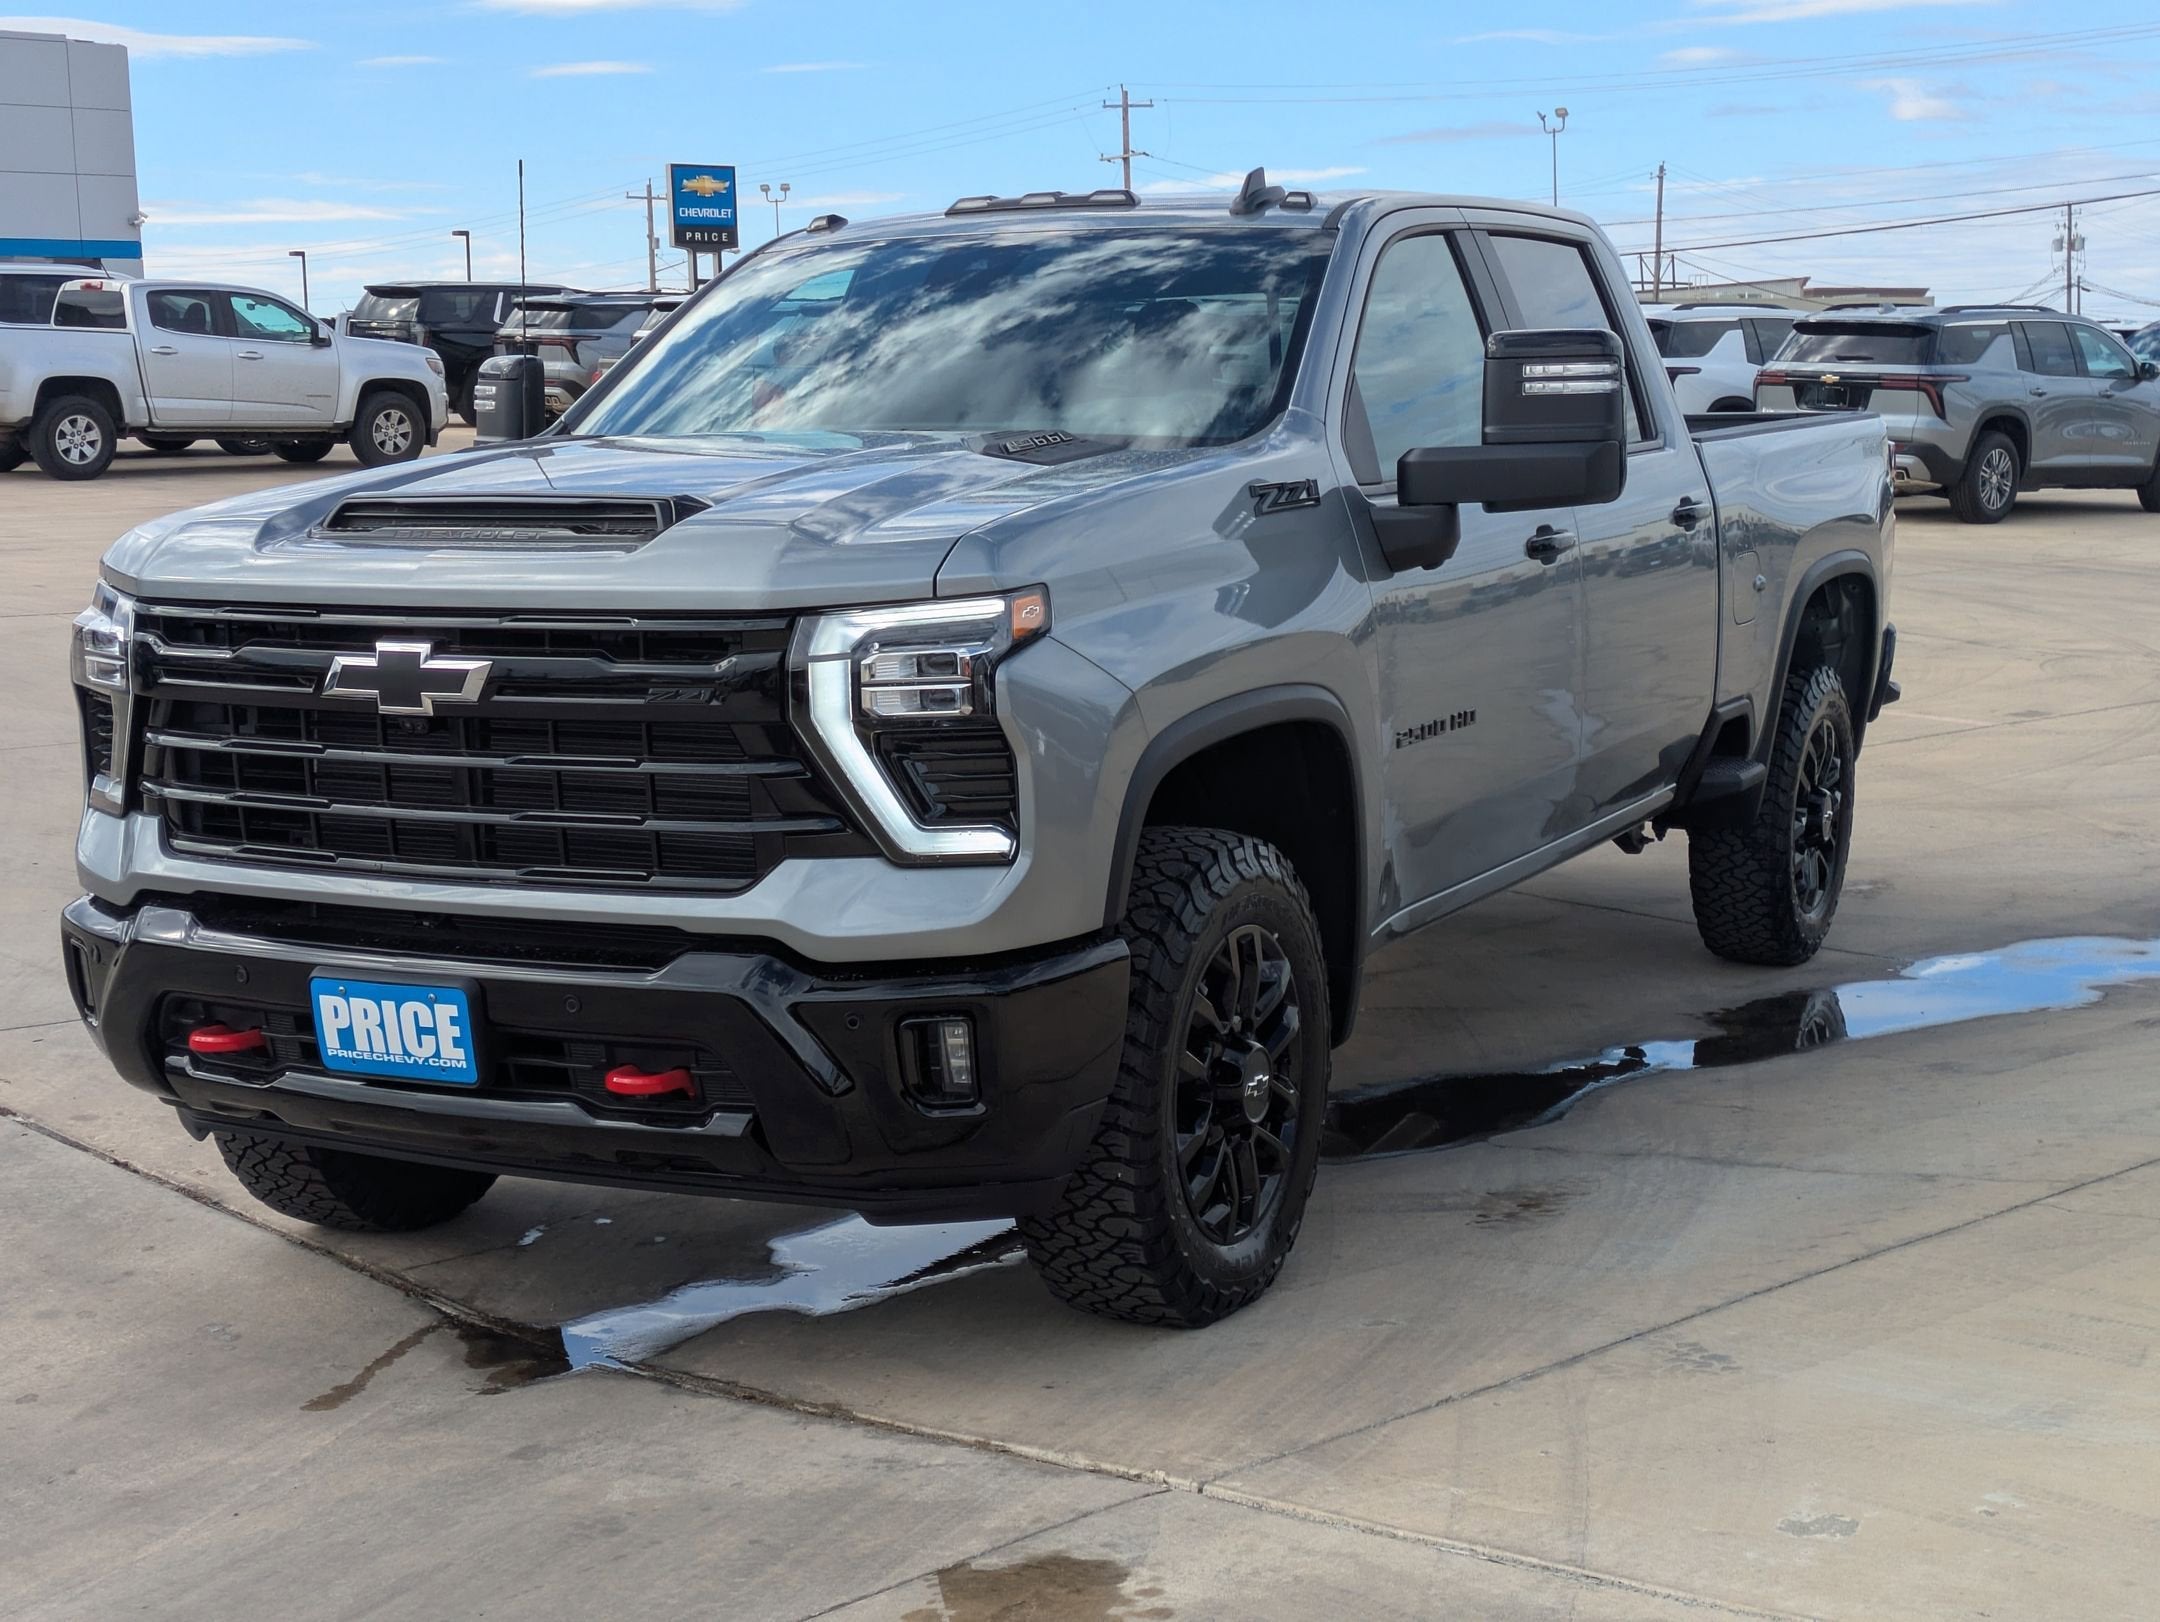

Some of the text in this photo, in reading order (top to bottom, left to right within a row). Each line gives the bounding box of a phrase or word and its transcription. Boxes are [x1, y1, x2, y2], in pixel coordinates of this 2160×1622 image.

[679, 207, 732, 219] CHEVROLET
[685, 231, 729, 242] PRICE
[1249, 479, 1321, 517] Z71
[1396, 709, 1477, 749] 2500 HD
[319, 994, 466, 1060] PRICE
[327, 1049, 467, 1069] PRICECHEVY.COM
